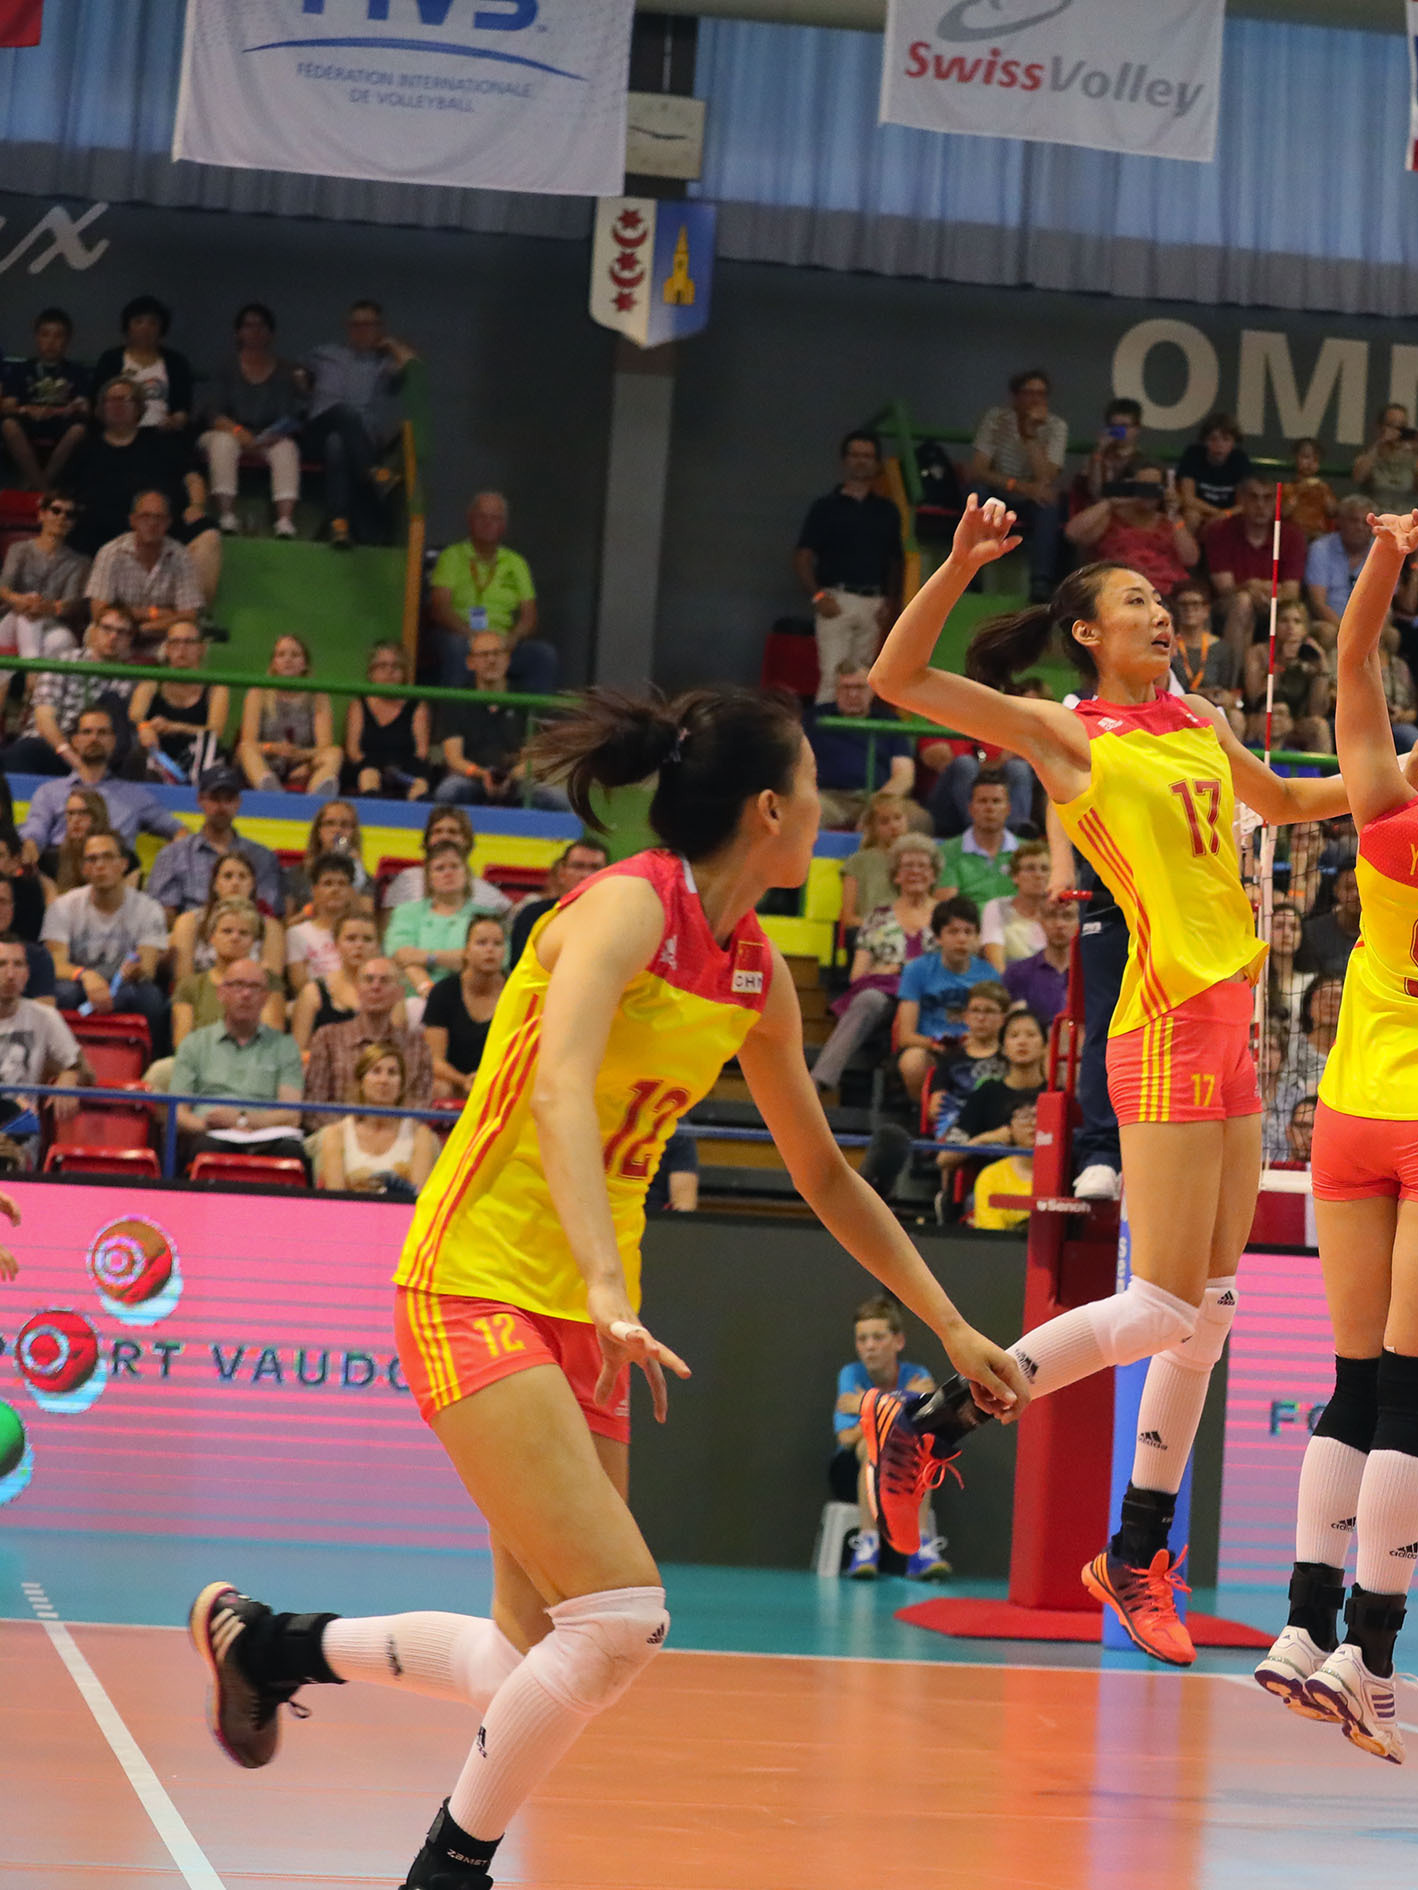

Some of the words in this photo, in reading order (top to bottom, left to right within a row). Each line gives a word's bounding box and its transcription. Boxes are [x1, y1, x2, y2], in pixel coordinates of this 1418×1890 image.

[1168, 778, 1222, 858] 17
[1190, 1073, 1216, 1107] 17
[603, 1079, 691, 1181] 12
[472, 1312, 526, 1359] 12
